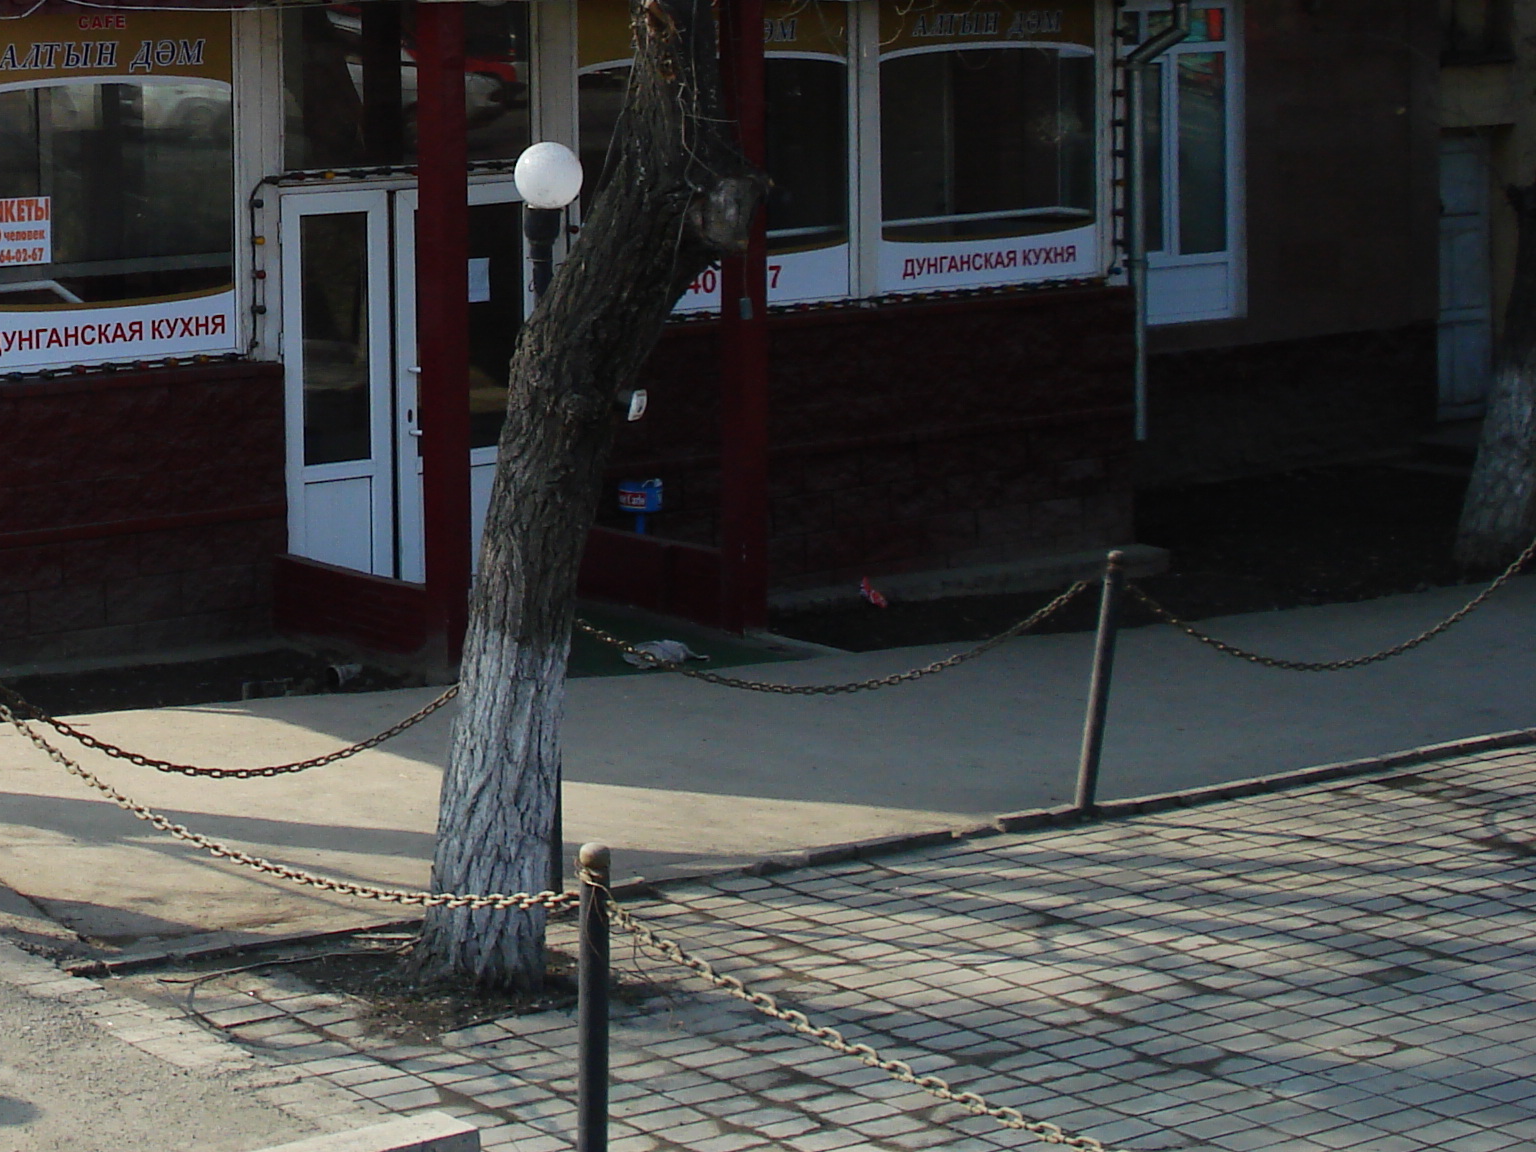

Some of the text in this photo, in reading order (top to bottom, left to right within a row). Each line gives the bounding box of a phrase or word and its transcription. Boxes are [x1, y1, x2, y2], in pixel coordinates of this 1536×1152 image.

[78, 15, 126, 30] CAFE
[129, 38, 206, 73] ДӘМ
[4, 229, 46, 242] человек
[0, 247, 44, 263] 64-02-67
[903, 245, 1077, 280] ДУНГАНСКАЯ КУХНЯ
[151, 314, 226, 342] КУХНЯ
